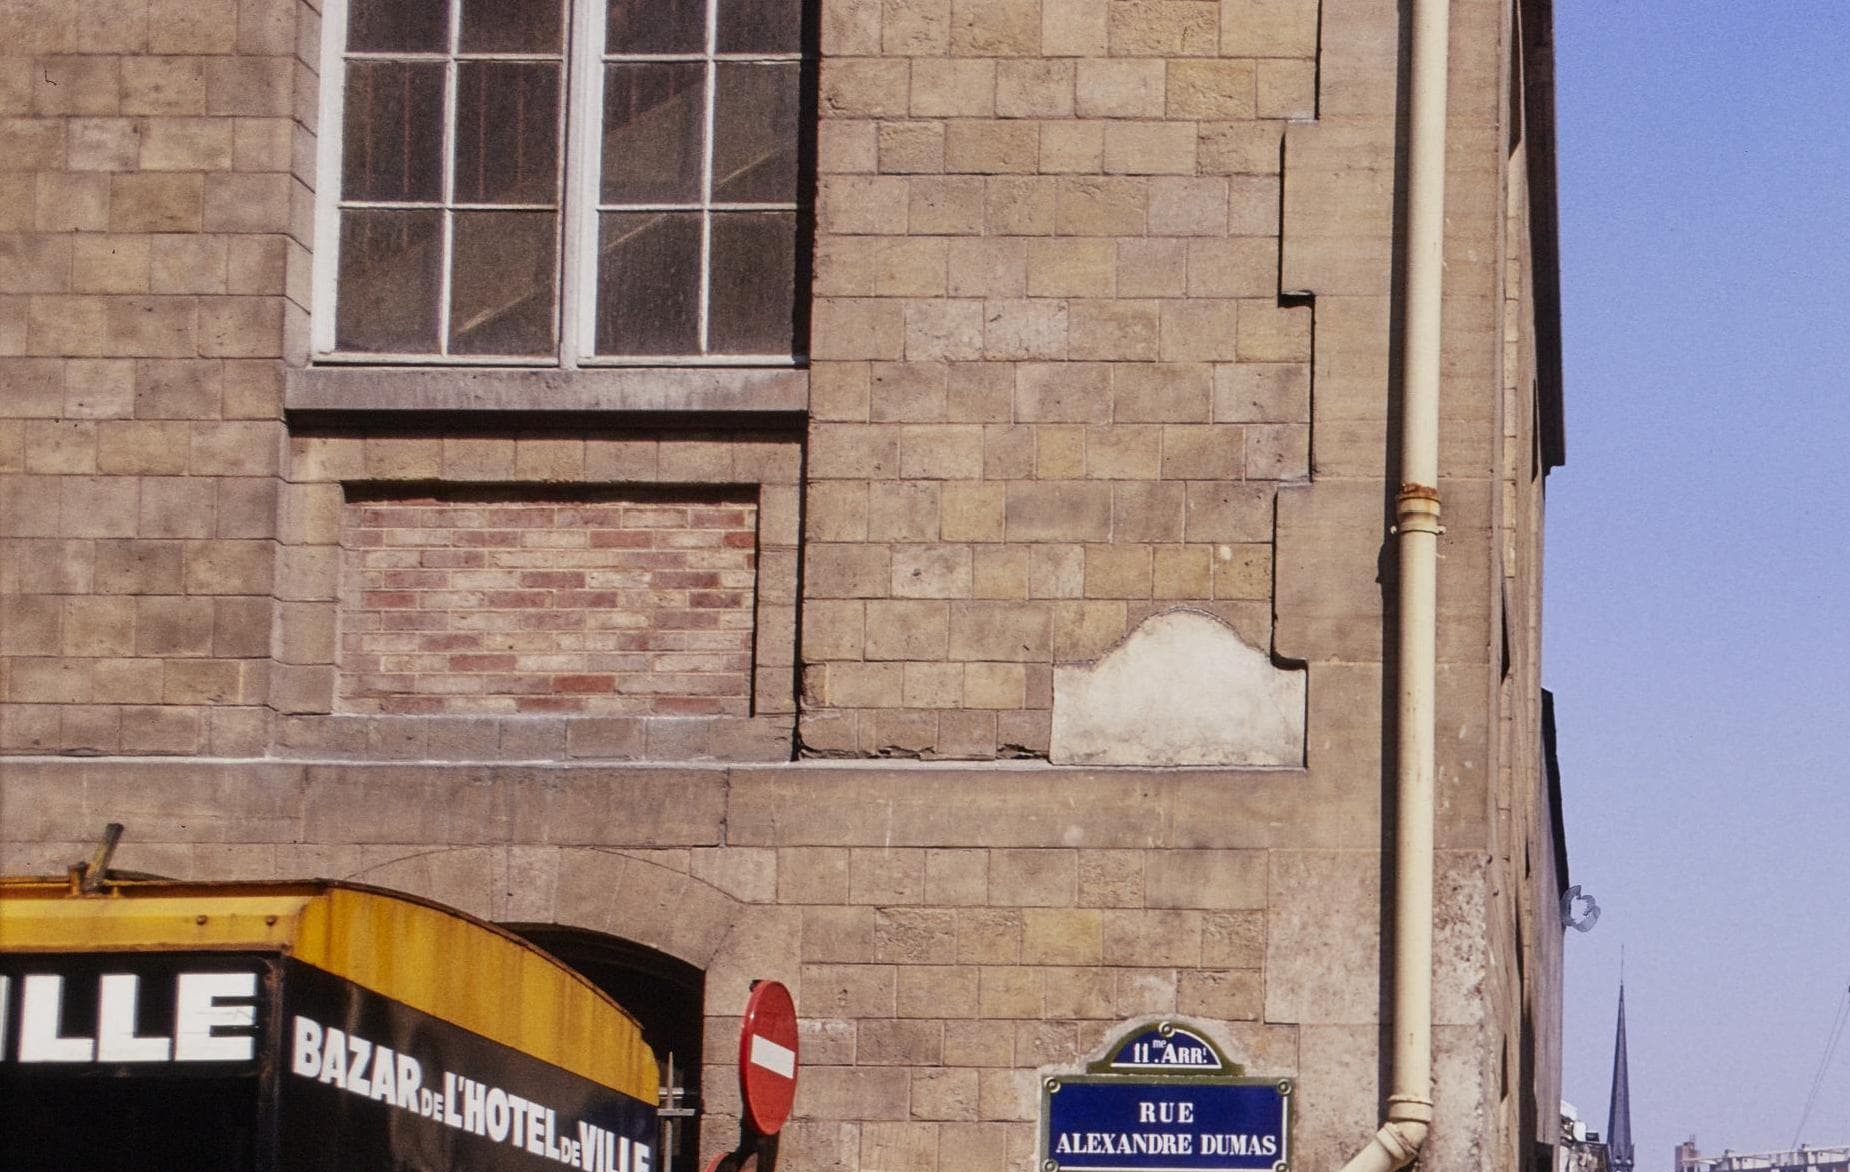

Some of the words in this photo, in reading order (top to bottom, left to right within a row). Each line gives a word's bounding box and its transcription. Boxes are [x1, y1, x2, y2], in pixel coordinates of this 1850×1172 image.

[0, 973, 258, 1063] LLE
[292, 1015, 420, 1114] BAZAR
[421, 1087, 445, 1123] DE
[444, 1071, 561, 1161] L'HOTEL
[560, 1136, 582, 1168] DE
[1139, 1102, 1194, 1123] RUE
[1055, 1133, 1193, 1155] ALEXANDRE
[1200, 1134, 1277, 1156] DUMAS
